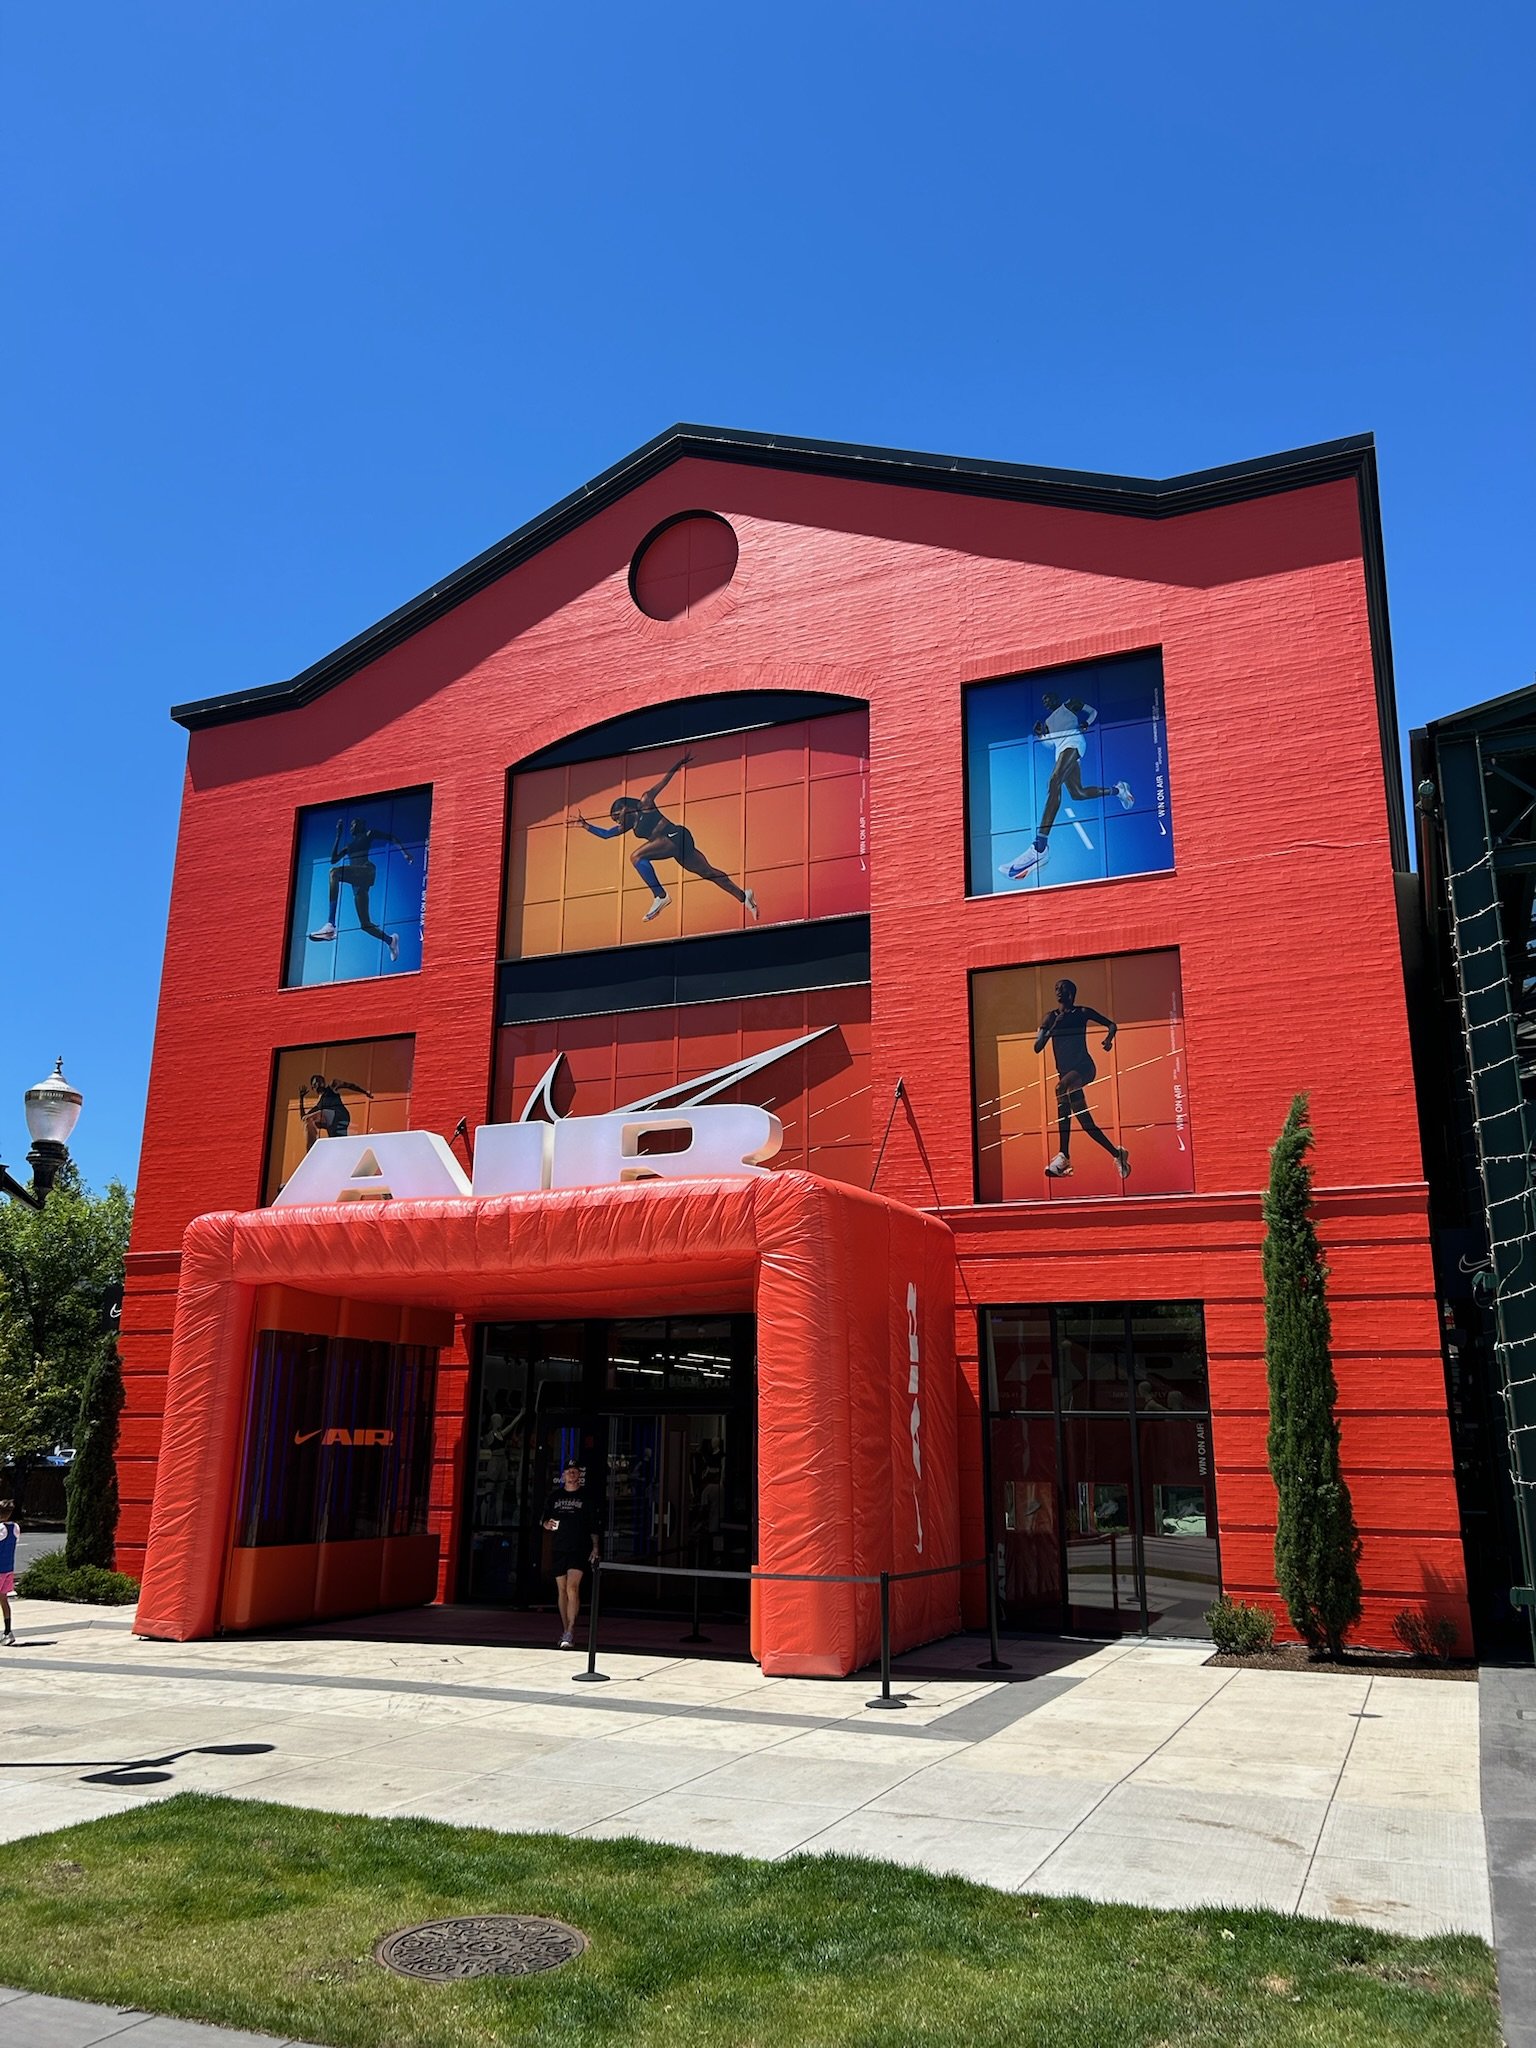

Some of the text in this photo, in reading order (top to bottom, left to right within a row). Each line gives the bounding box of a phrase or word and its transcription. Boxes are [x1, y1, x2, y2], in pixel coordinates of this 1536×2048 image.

[1155, 775, 1164, 789] AIR
[1157, 789, 1165, 802] ON
[1158, 802, 1166, 818] WIN
[860, 829, 866, 841] ON
[1174, 1084, 1182, 1100] AIR
[1175, 1100, 1183, 1114] ON
[1176, 1115, 1184, 1131] WIN
[272, 1104, 784, 1207] AIR
[906, 1281, 922, 1481] AIR
[321, 1428, 394, 1446] AIR
[1196, 1422, 1208, 1476] WIN ON AIR
